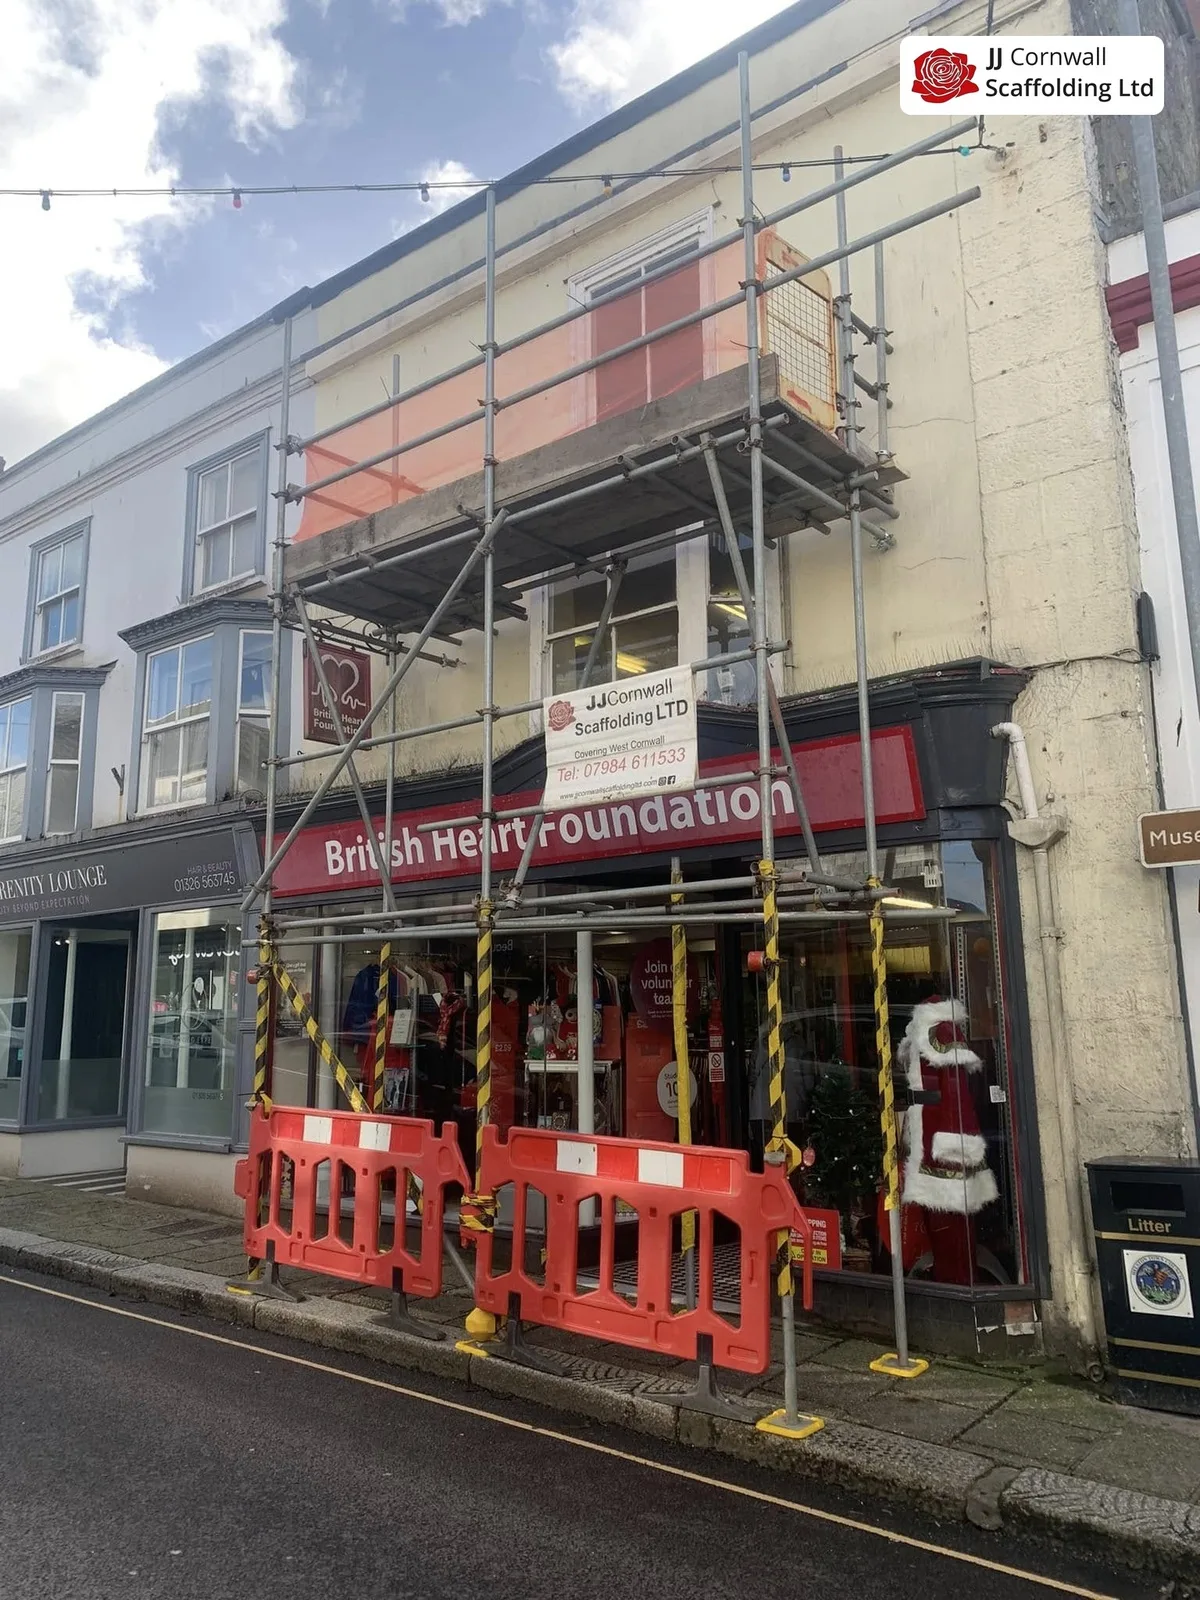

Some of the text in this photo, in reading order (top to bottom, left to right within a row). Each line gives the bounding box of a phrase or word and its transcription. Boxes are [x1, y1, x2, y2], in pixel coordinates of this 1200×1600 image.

[575, 699, 688, 736] Scaffolding LTD
[574, 735, 665, 759] Covering West Cornwall
[557, 747, 686, 782] Tel: 07984 611533
[538, 780, 795, 848] Foundation
[207, 860, 232, 872] BEAUTY
[48, 864, 107, 893] LOUNGE
[174, 871, 236, 892] 01326 563745
[12, 901, 39, 913] BEYOND
[41, 894, 90, 910] EXPECTATION
[644, 960, 668, 974] Join
[653, 994, 674, 1005] tea
[1127, 1218, 1172, 1233] Litter
